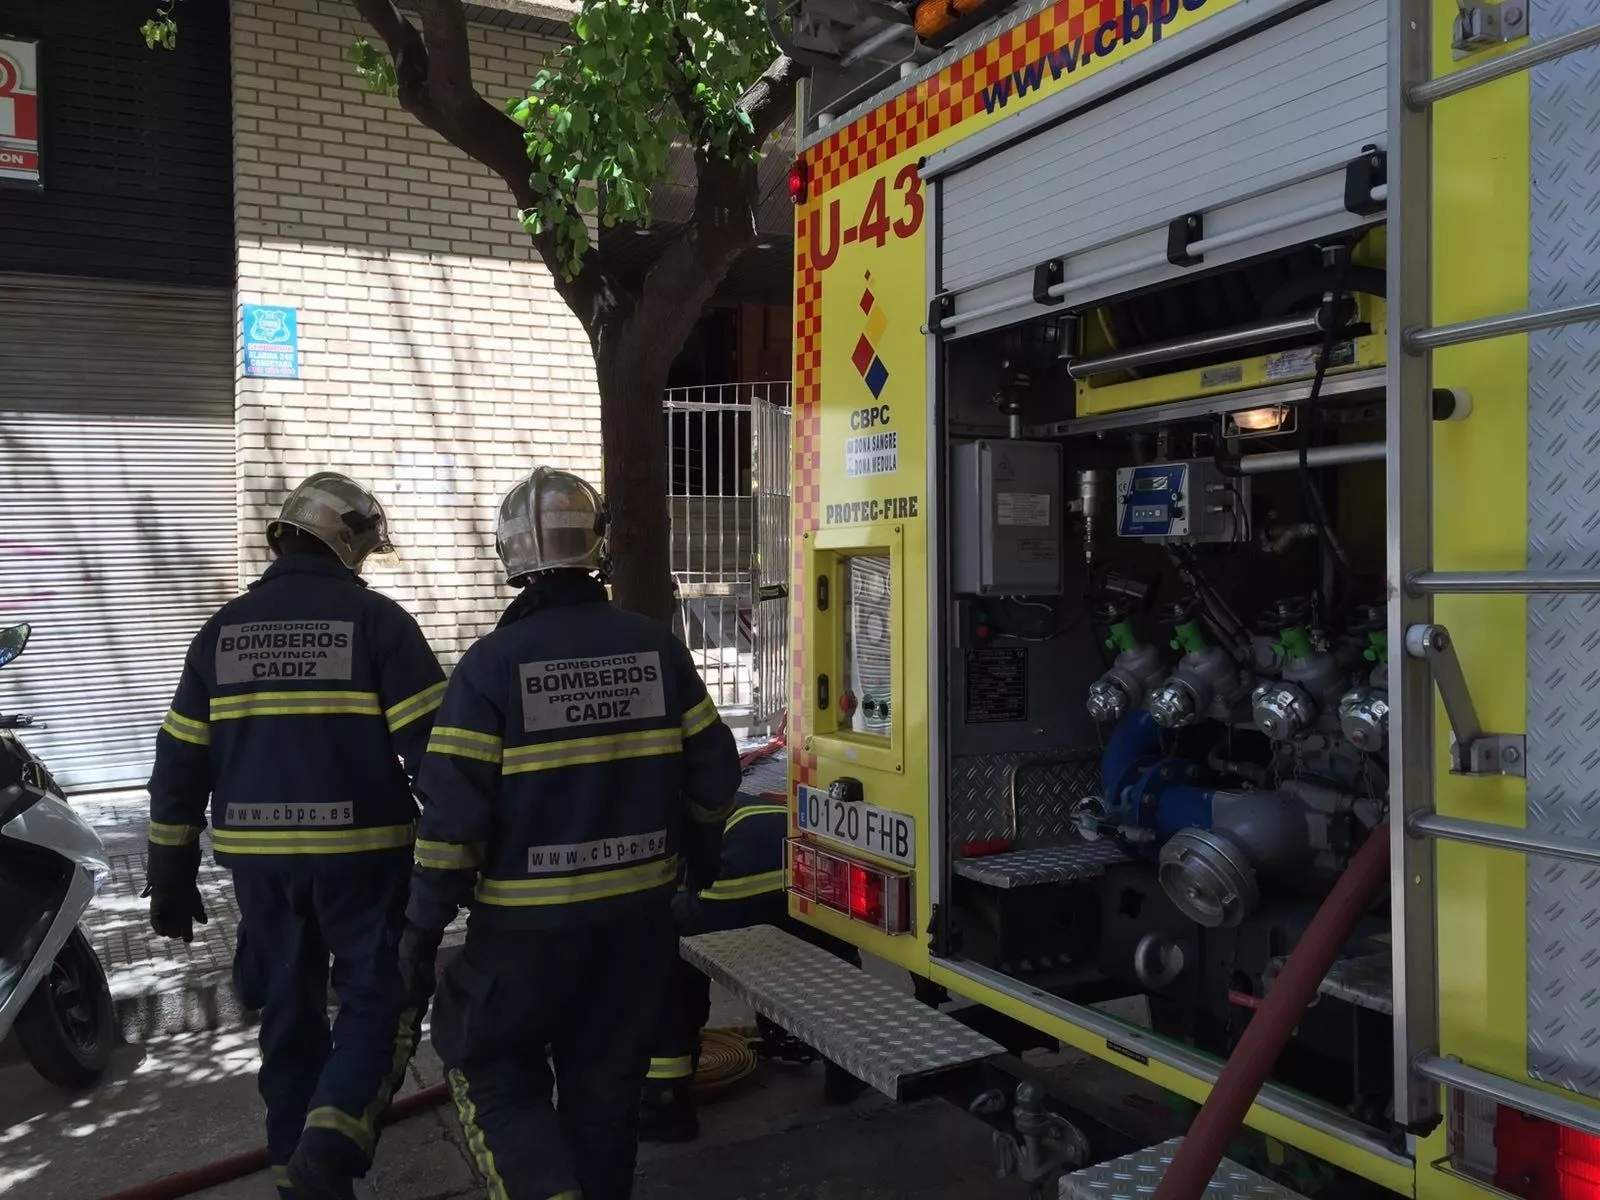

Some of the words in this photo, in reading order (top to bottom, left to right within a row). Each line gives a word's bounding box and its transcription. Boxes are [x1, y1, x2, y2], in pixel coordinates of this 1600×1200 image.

[810, 163, 924, 271] U-43
[851, 404, 890, 430] CBPC
[854, 438, 871, 454] DONA
[872, 432, 897, 451] SANGRE
[854, 459, 871, 475] DONA
[826, 496, 918, 524] PROTEC-FIRE
[241, 623, 330, 633] CONSORCIO
[221, 633, 348, 652] BOMBEROS
[238, 651, 328, 661] PROVINCIA
[545, 655, 637, 672] CONSORCIO
[252, 662, 317, 678] CADIZ
[526, 665, 658, 694] BOMBEROS
[549, 687, 640, 704] PROVINCIA
[565, 700, 631, 723] CADIZ
[227, 805, 351, 820] www.cbpc.es
[809, 794, 859, 841] 0120
[866, 811, 909, 858] FHB
[532, 835, 665, 866] www.cbpc.es
